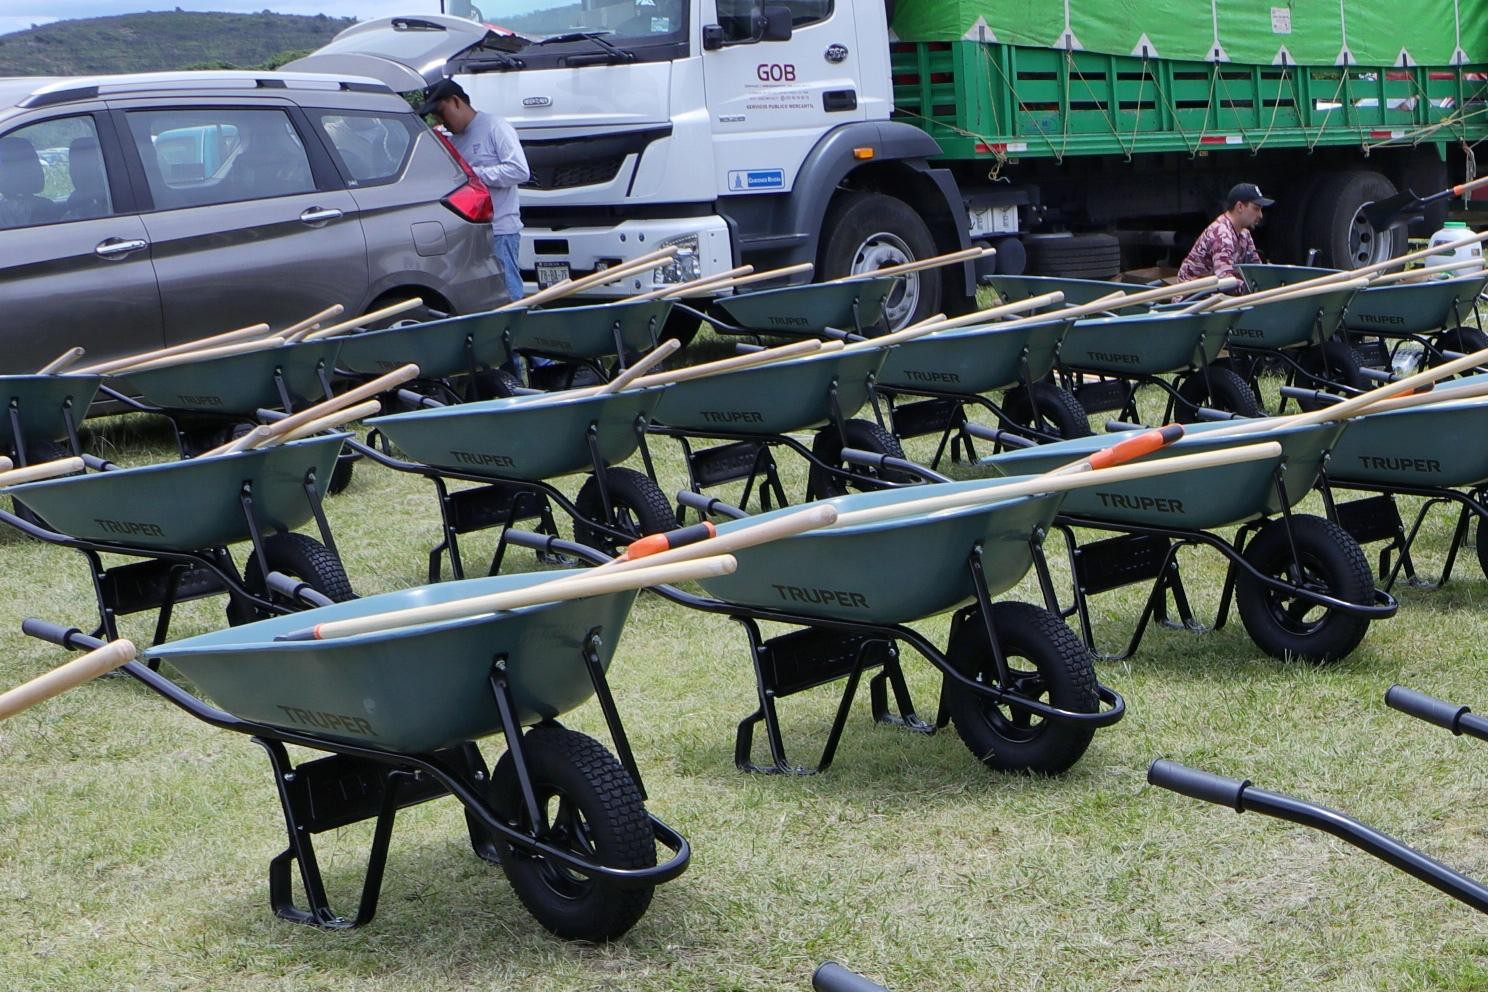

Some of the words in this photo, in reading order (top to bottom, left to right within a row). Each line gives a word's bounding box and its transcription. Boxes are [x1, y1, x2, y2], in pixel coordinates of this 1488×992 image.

[757, 64, 796, 81] GOB
[768, 316, 810, 326] TRUPER
[1358, 314, 1405, 325] TRUPER
[1087, 351, 1140, 364] TRUPER
[904, 370, 961, 383] TRUPER
[700, 411, 763, 423] TRUPER
[450, 451, 516, 468] TRUPER
[1358, 456, 1442, 472] TRUPER
[1096, 492, 1185, 513] TRUPER
[94, 519, 165, 537] TRUPER
[771, 584, 871, 608] TRUPER
[276, 704, 379, 736] TRUPER
